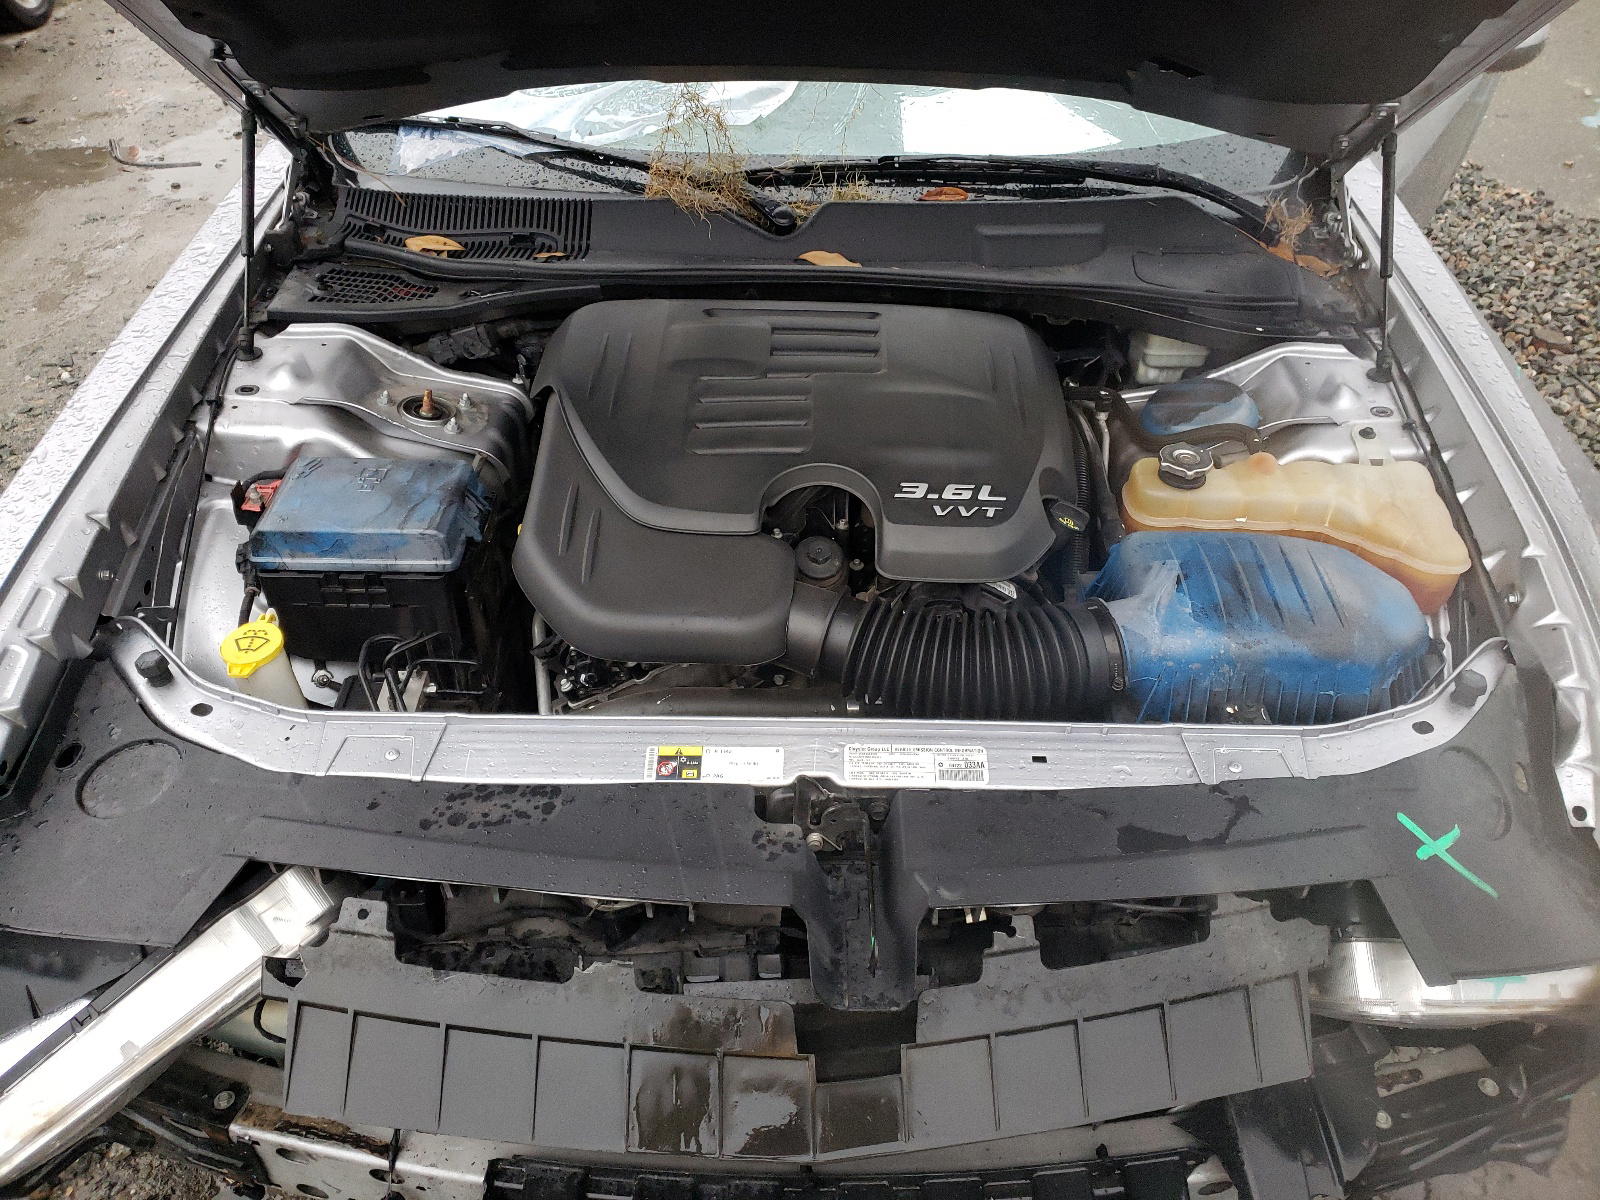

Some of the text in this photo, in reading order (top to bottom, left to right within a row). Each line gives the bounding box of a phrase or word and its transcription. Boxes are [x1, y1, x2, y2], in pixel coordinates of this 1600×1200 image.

[894, 482, 1007, 501] 3.6L
[933, 505, 1003, 518] VVT
[964, 761, 985, 769] 033AA
